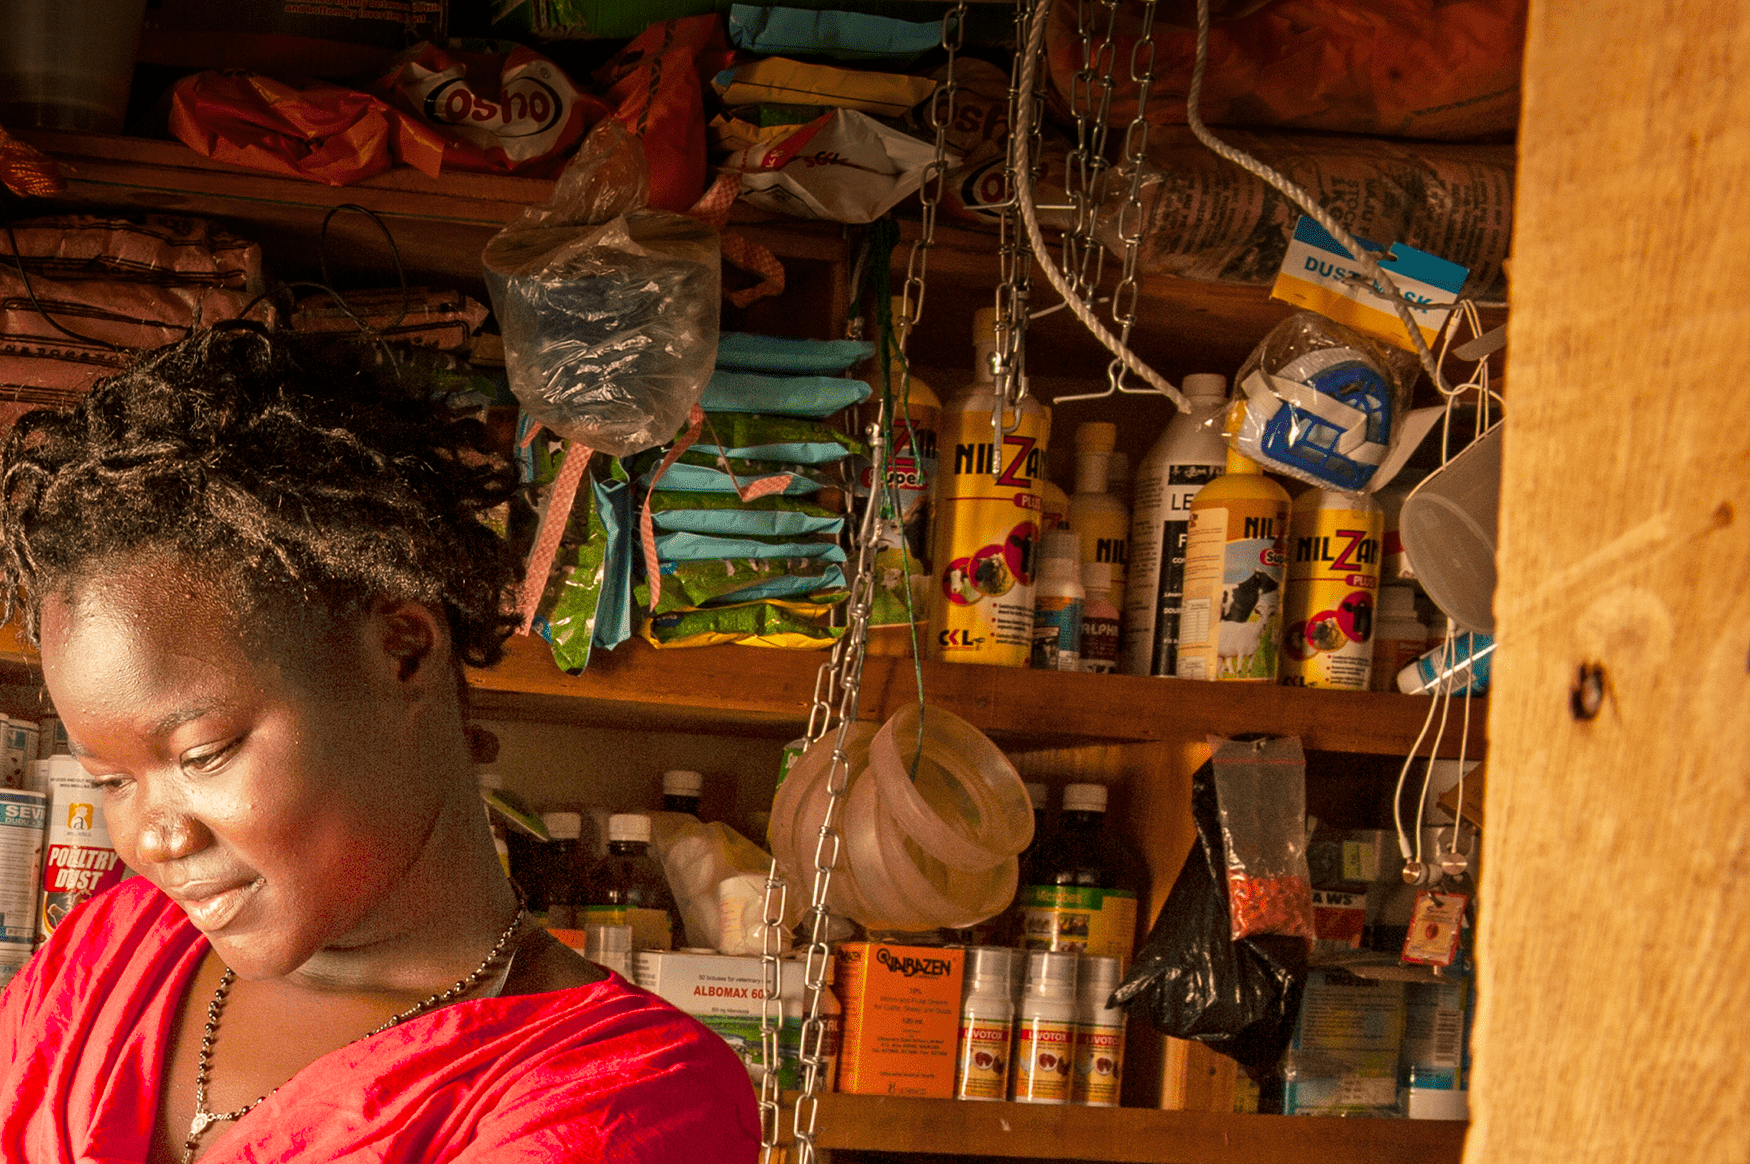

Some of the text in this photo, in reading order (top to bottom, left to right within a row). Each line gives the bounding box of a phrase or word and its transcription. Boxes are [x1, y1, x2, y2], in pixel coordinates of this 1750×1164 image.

[1097, 539, 1125, 563] NIL
[939, 629, 974, 646] CKL
[5, 805, 45, 819] SEVI
[48, 847, 119, 869] POULTRY
[55, 869, 104, 891] DUST
[694, 985, 748, 998] ALBOMAX
